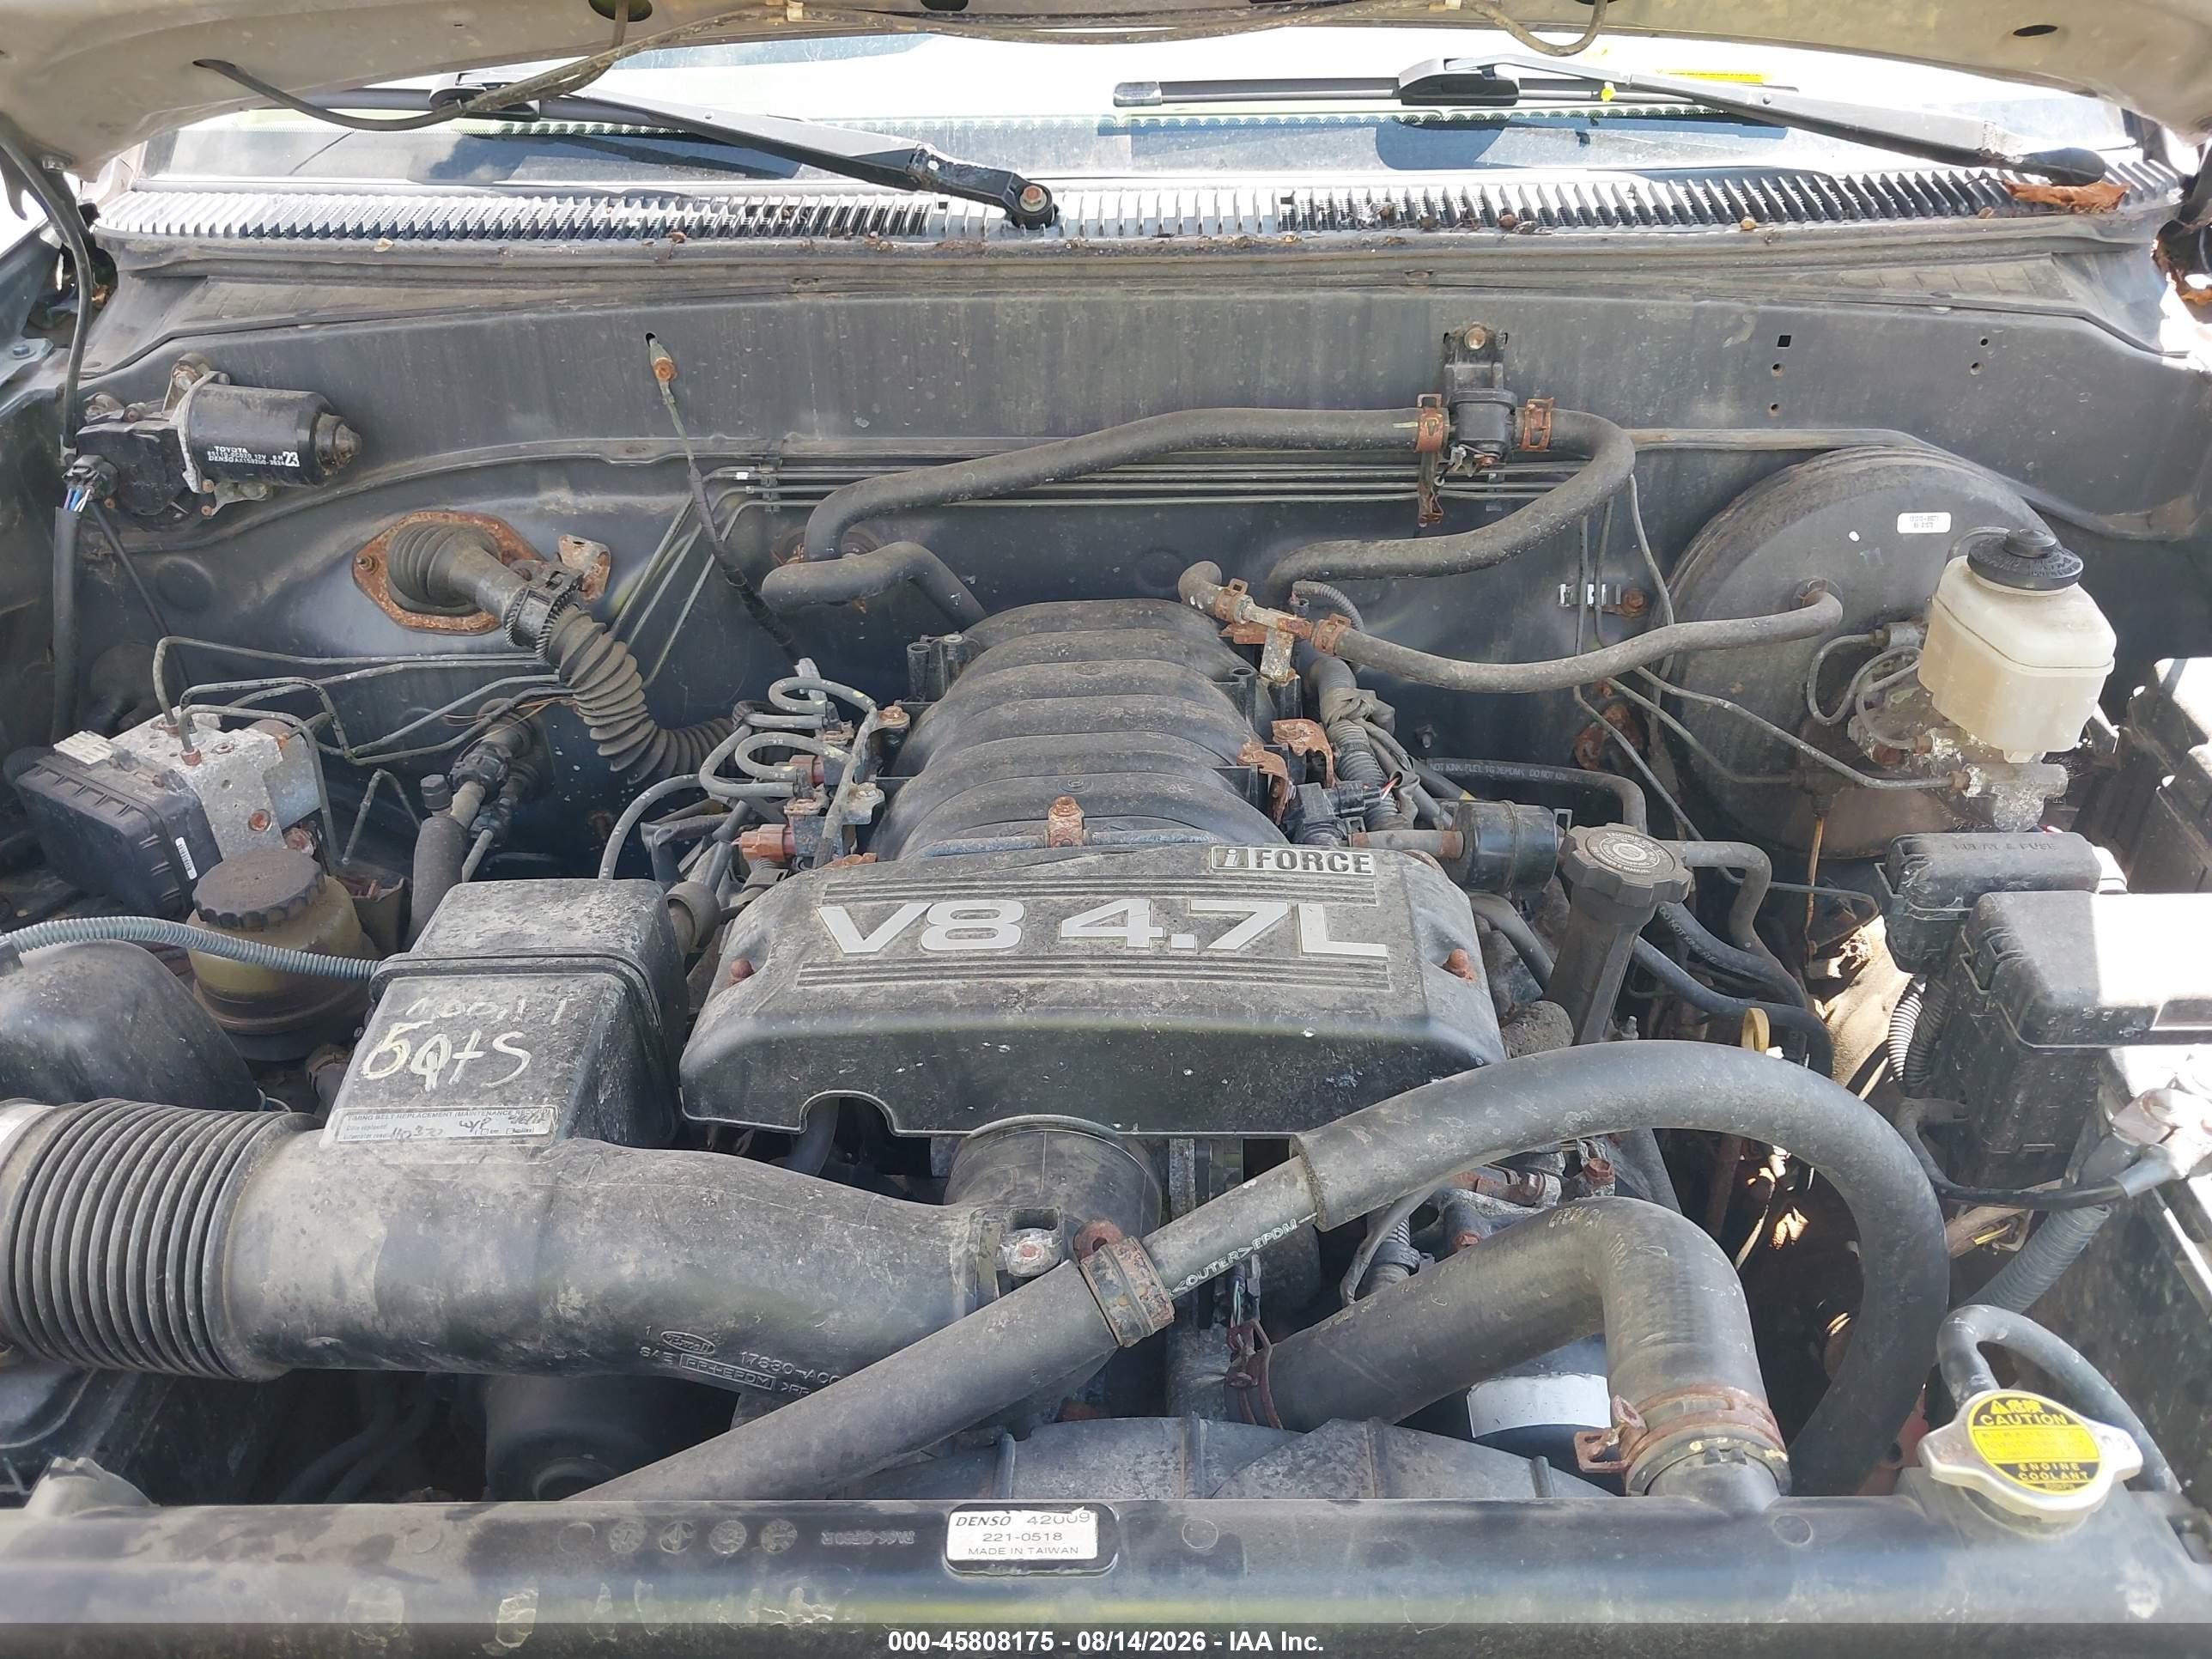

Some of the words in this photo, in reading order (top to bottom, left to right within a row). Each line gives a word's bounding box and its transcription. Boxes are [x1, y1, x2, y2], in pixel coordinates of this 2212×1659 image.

[1256, 849, 1372, 874] FORCE
[818, 899, 1024, 955] V8
[1060, 898, 1389, 960] 4.7L
[1979, 1414, 2069, 1426] CAUTION
[2019, 1462, 2080, 1472] ENGINE
[2019, 1472, 2088, 1481] COOLANT
[956, 1516, 1012, 1526] DENSO
[982, 1532, 1063, 1542] 221-0518
[1027, 1547, 1079, 1555] TAIWAN
